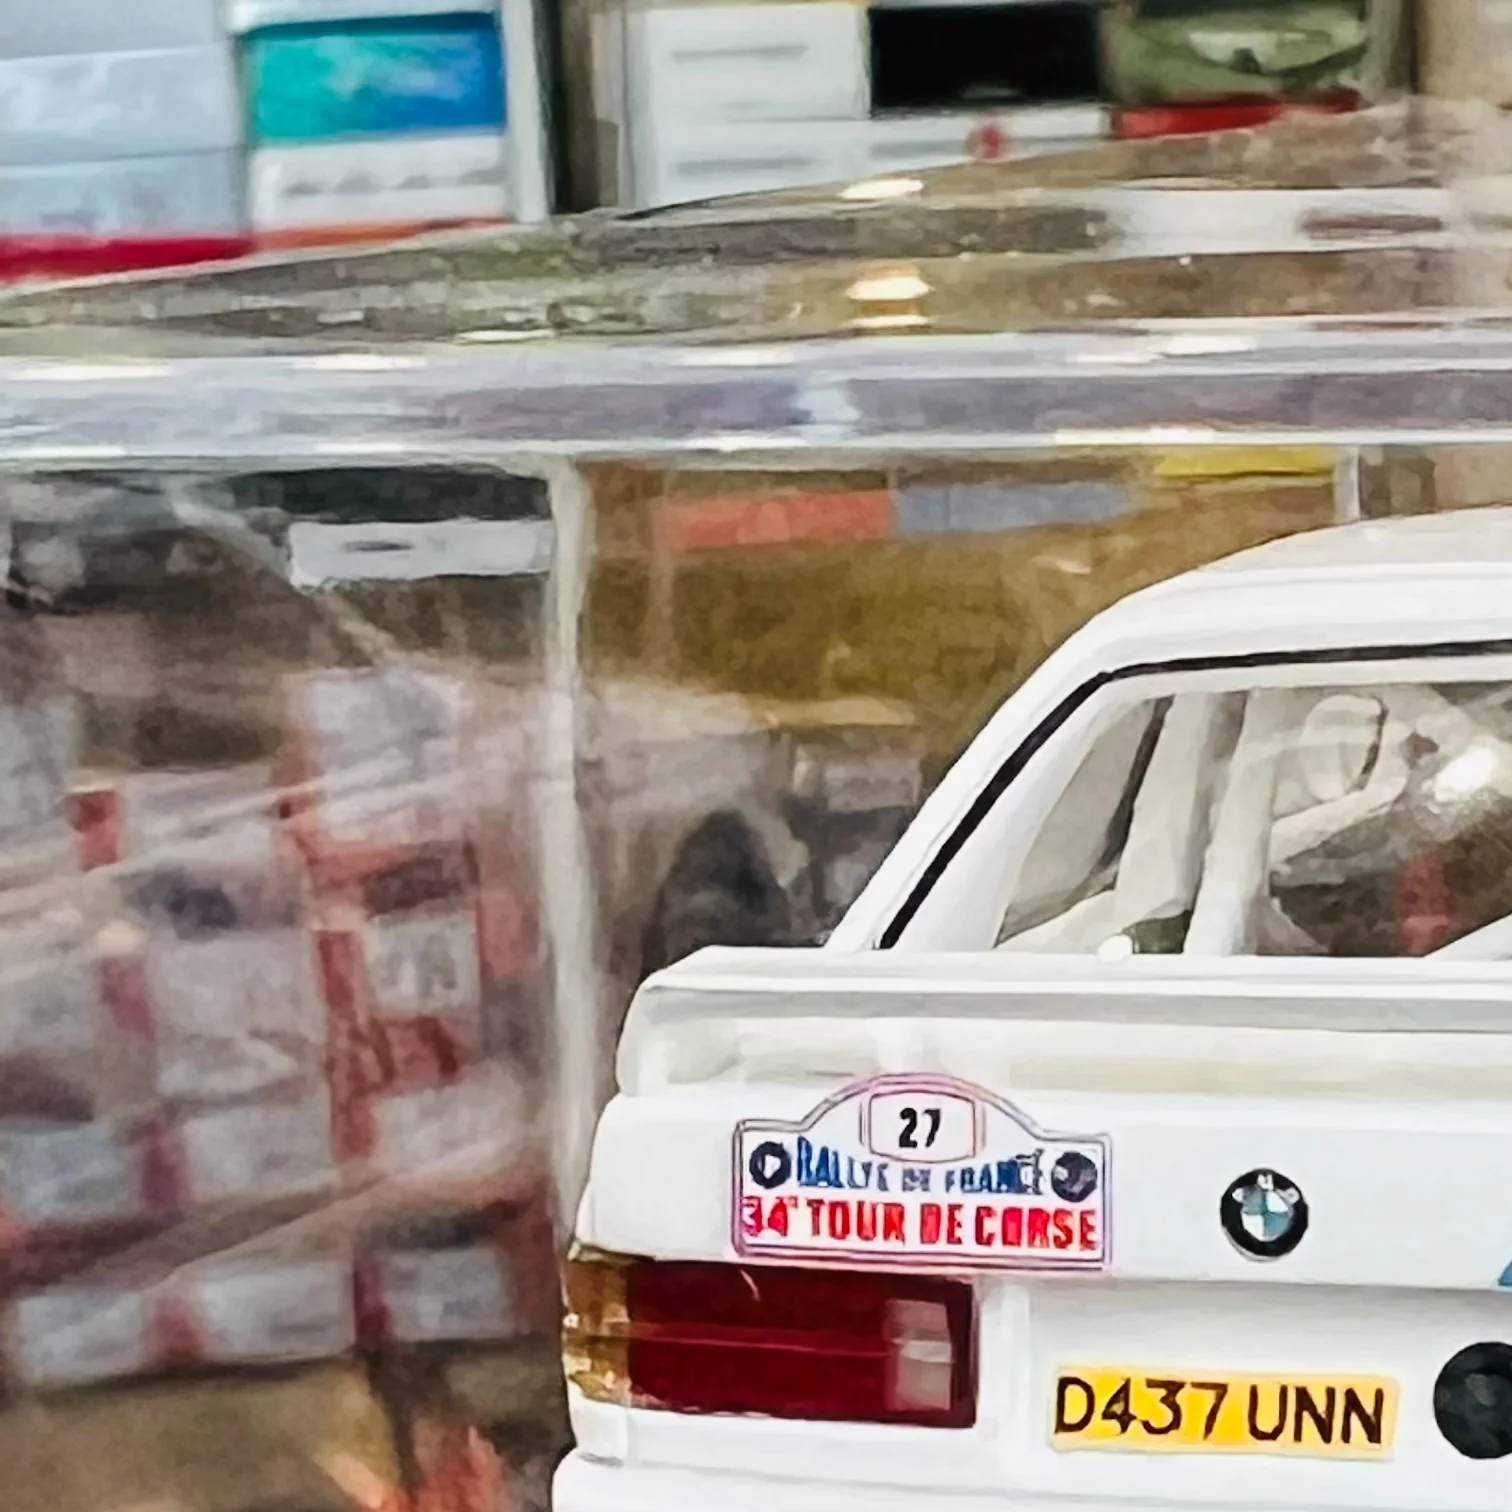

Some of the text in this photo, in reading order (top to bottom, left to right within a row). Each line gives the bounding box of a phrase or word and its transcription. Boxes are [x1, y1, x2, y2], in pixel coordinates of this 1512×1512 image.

[898, 1107, 941, 1149] 27
[808, 1199, 906, 1247] TOUR
[920, 1202, 963, 1247] DE
[975, 1206, 1098, 1251] CORSE
[1054, 1375, 1385, 1445] D437 UNN
